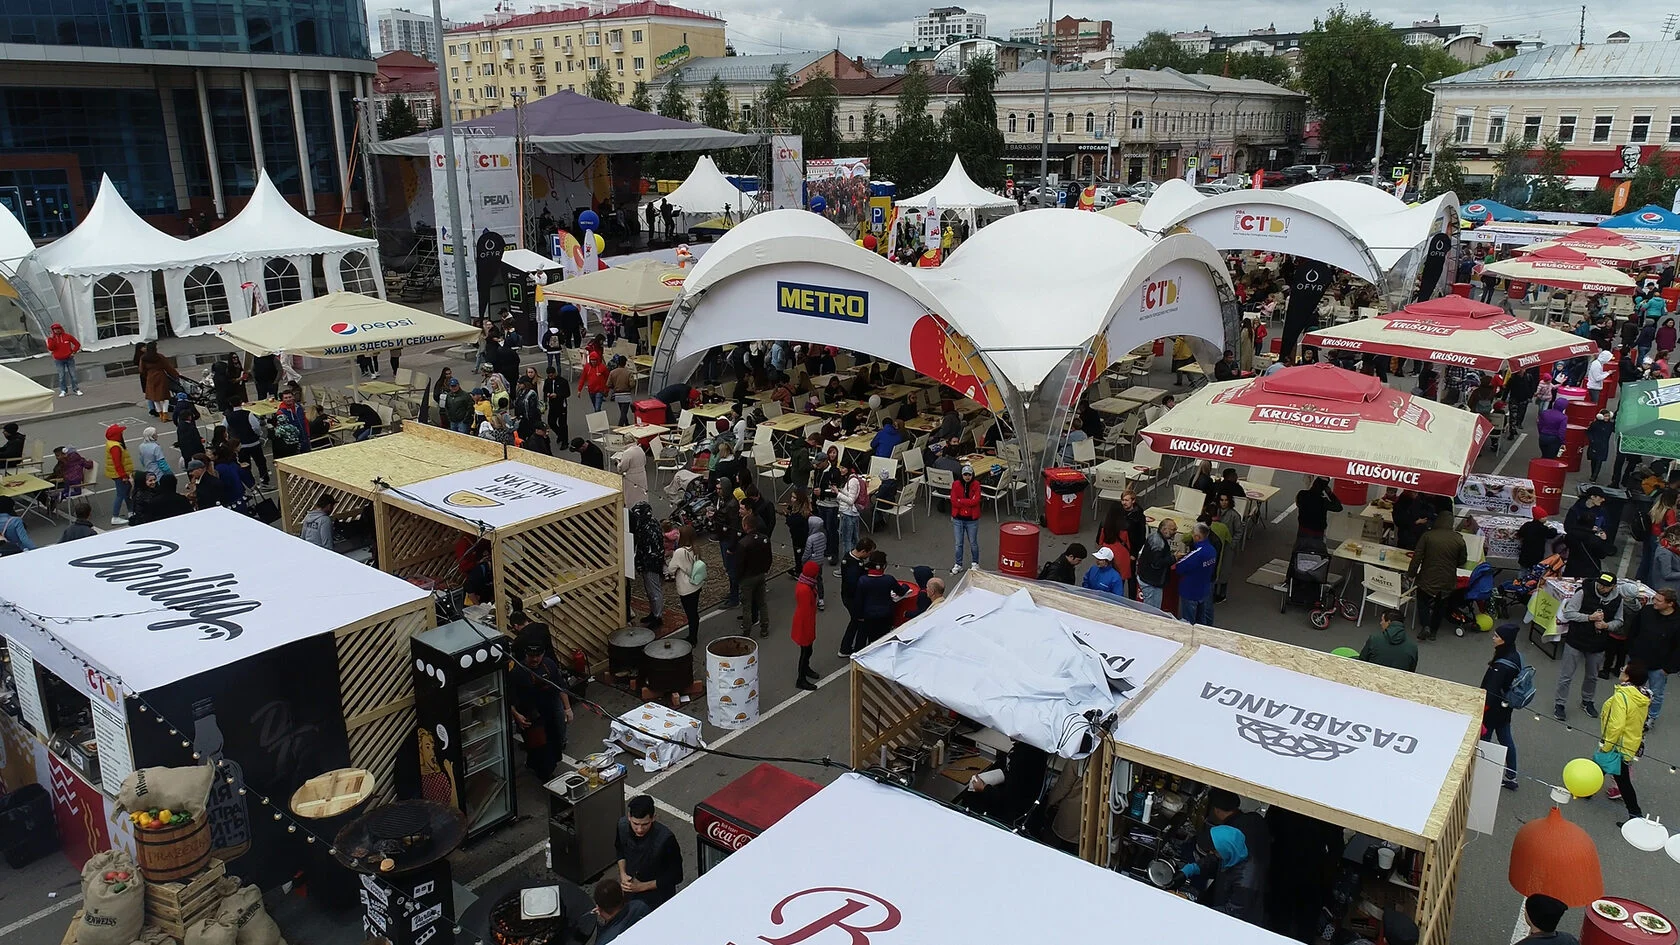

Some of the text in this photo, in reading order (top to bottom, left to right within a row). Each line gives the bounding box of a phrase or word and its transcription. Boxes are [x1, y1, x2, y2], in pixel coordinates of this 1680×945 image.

[1059, 192, 1067, 203] P
[873, 208, 882, 222] P
[1297, 283, 1323, 292] OFYR
[1582, 283, 1618, 293] KRUŠOVICE
[781, 287, 865, 318] METRO
[361, 318, 414, 333] pepsi
[1391, 320, 1452, 335] KRUŠOVICE
[324, 334, 445, 356] ЖИВИ ЗДЕСЬ И СЕЙЧАС
[1321, 337, 1363, 349] KRUŠOVICE
[1430, 350, 1477, 366] KRUŠOVICE
[1258, 407, 1350, 428] KRUŠOVICE
[1169, 438, 1235, 458] KRUŠOVICE
[1346, 460, 1421, 486] KRUŠOVICE
[1371, 577, 1393, 587] AMSTEL
[1200, 681, 1419, 754] CASABLANCA
